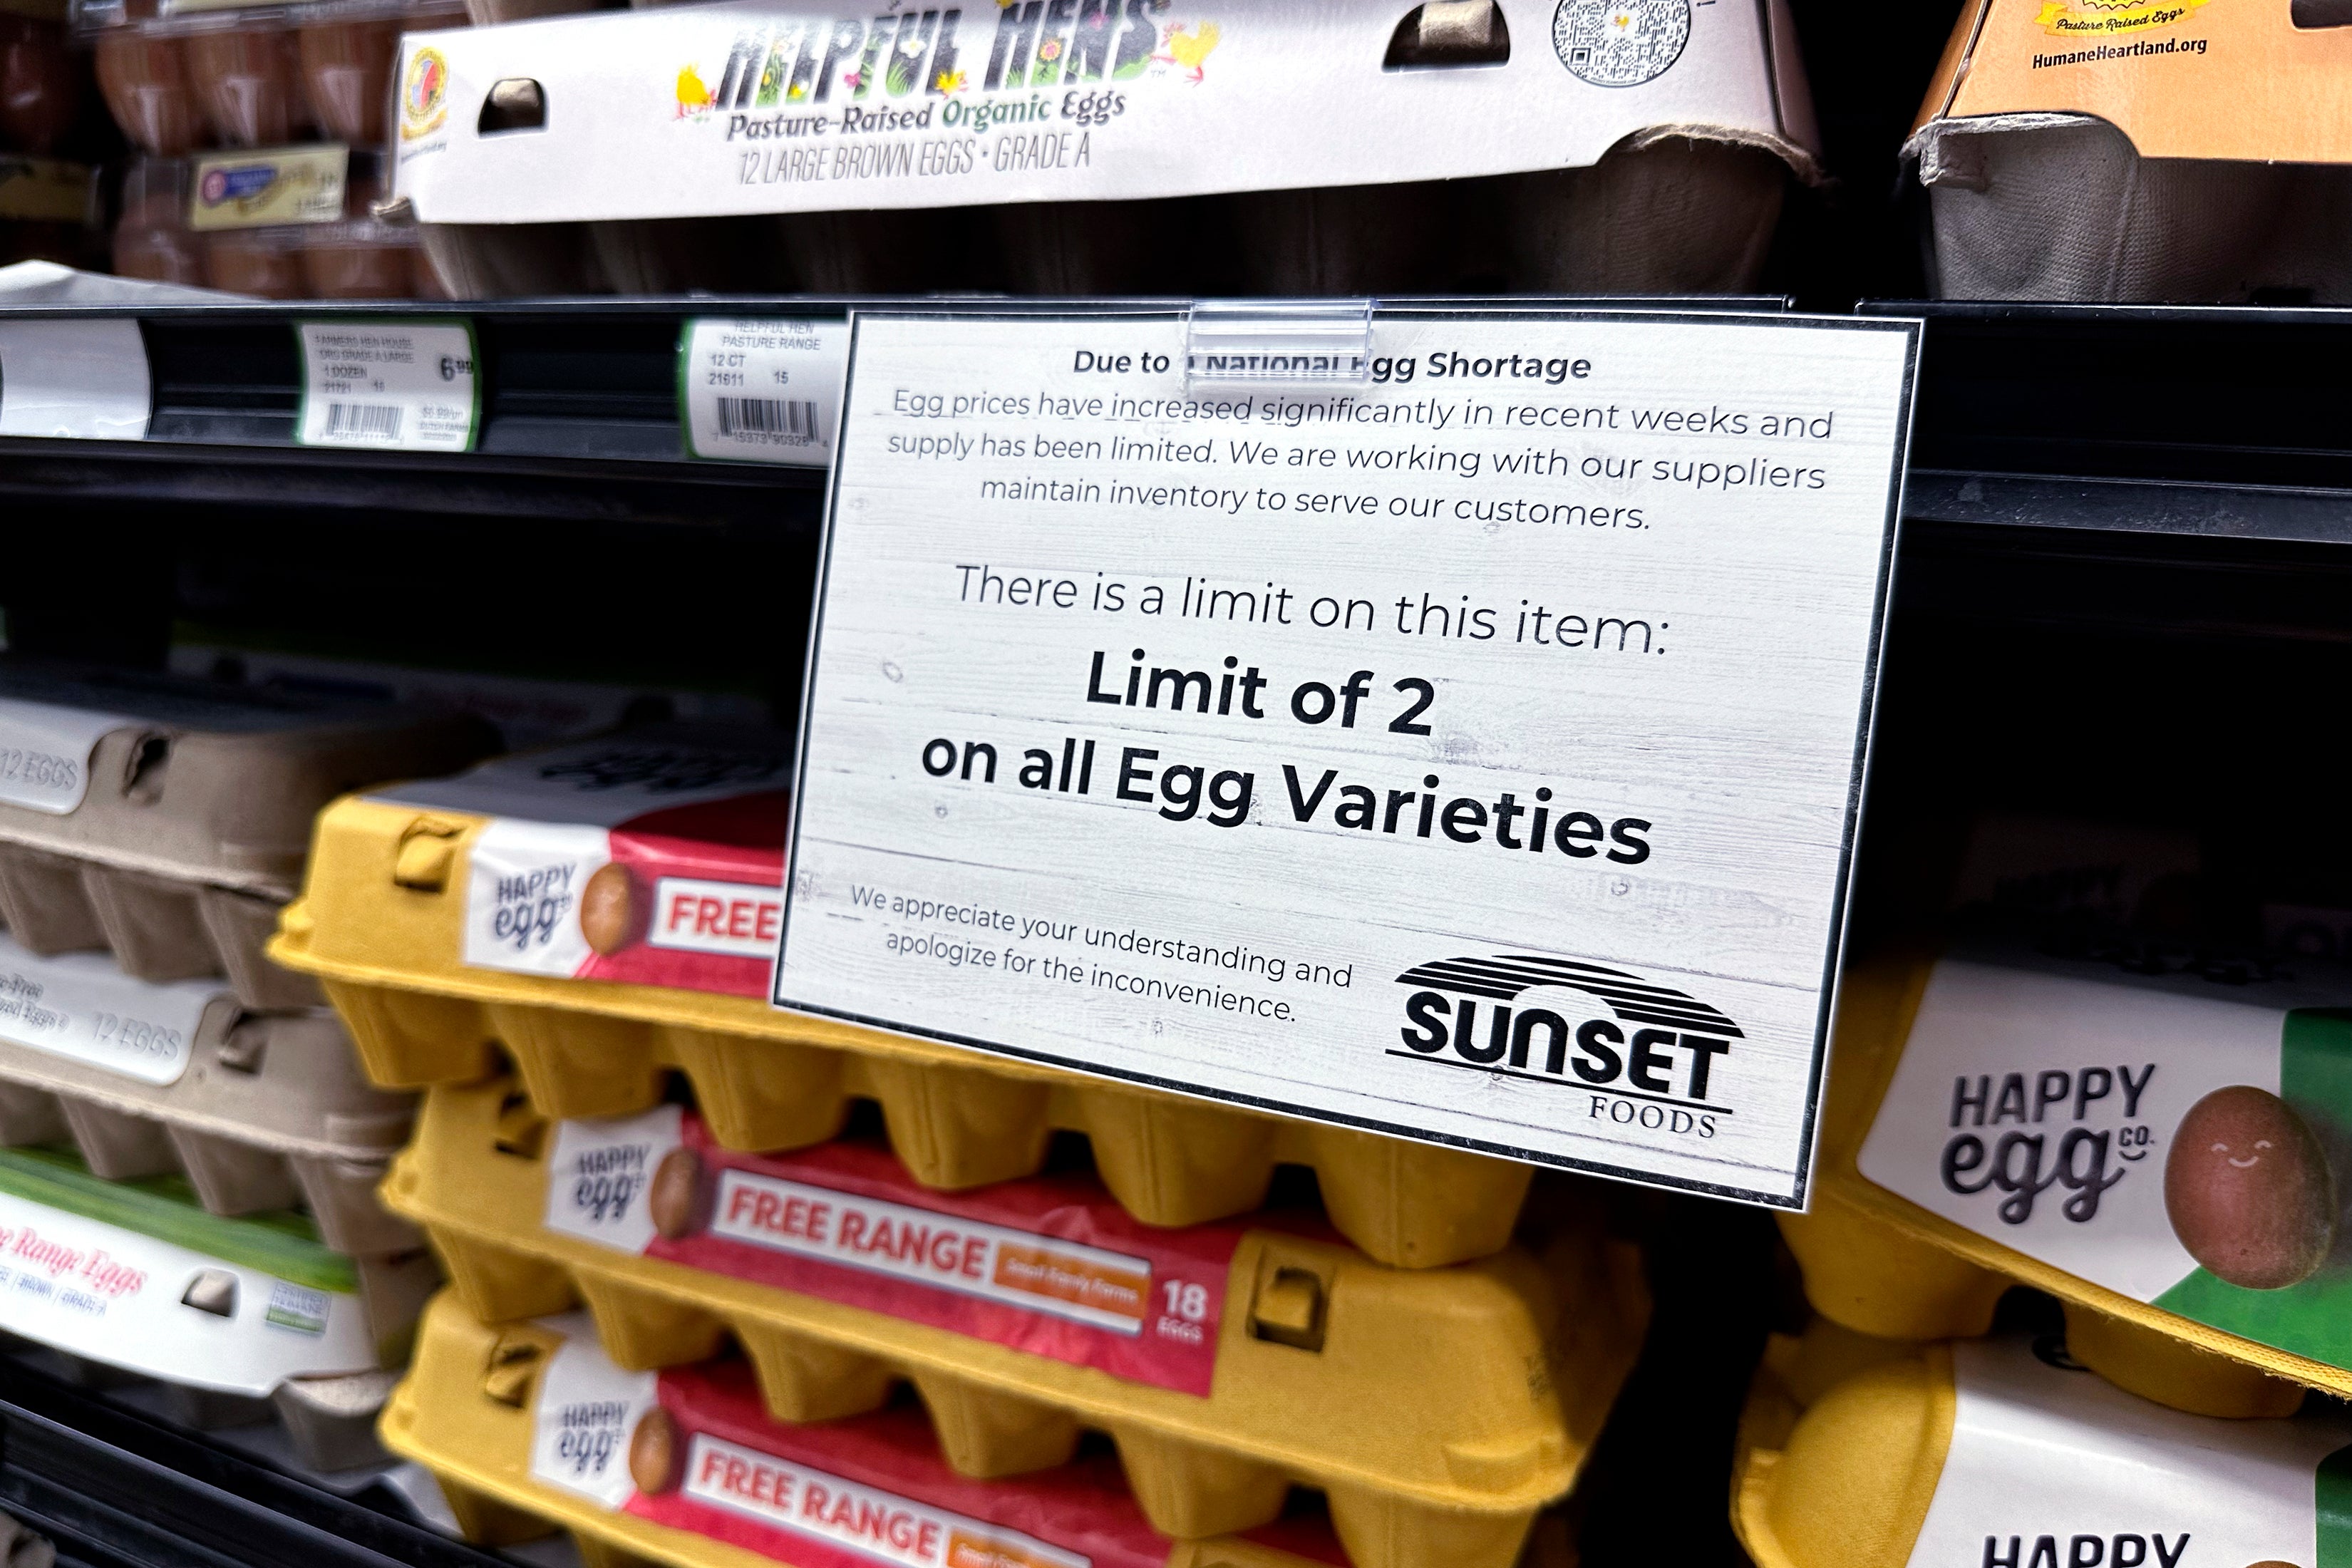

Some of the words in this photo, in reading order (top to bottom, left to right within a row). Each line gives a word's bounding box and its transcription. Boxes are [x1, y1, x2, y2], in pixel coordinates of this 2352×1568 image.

[2056, 19, 2103, 30] Pasture
[2106, 15, 2150, 31] Raised
[2152, 8, 2186, 23] Eggs
[2032, 38, 2208, 69] HumaneHeartland.org
[727, 103, 933, 141] Pasture-Raised
[943, 96, 1051, 133] Organic
[1061, 91, 1126, 128] Eggs
[740, 152, 760, 185] 12
[764, 148, 827, 183] LARGE
[834, 143, 914, 180] BROWN
[920, 140, 975, 175] EGGS
[996, 133, 1070, 172] GRADE
[1076, 131, 1090, 167] A
[711, 354, 726, 367] 12
[727, 354, 746, 367] CT
[722, 336, 775, 349] PASTURE
[779, 338, 822, 351] RANGE
[331, 366, 368, 378] DOZEN
[774, 371, 789, 384] 15
[1074, 351, 1131, 373] Due
[1141, 352, 1170, 373] to
[1427, 351, 1591, 385] Shortage
[894, 390, 944, 418] Egg
[951, 391, 1030, 418] prices
[1039, 392, 1103, 416] have
[1113, 393, 1252, 419] increased
[1261, 395, 1455, 430] significantly
[1465, 399, 1492, 424] in
[1506, 406, 1619, 428] recent
[1631, 406, 1748, 434] weeks
[1761, 411, 1832, 438] and
[888, 432, 974, 460] supply
[981, 433, 1026, 457] has
[1035, 434, 1100, 459] been
[1112, 436, 1216, 463] limited.
[1231, 441, 1277, 465] We
[1288, 448, 1336, 467] are
[1347, 445, 1480, 478] working
[1493, 448, 1567, 475] with
[1582, 458, 1642, 478] our
[1652, 458, 1825, 490] suppliers
[982, 477, 1100, 502] maintain
[1110, 480, 1248, 515] inventory
[1257, 488, 1286, 510] to
[1295, 494, 1378, 515] serve
[1389, 497, 1445, 517] our
[1455, 500, 1649, 529] customers.
[956, 565, 1077, 608] There
[1094, 572, 1125, 612] is
[1140, 587, 1163, 614] a
[1182, 577, 1293, 624] limit
[1310, 598, 1373, 631] on
[1396, 593, 1496, 639] this
[1517, 599, 1668, 654] item:
[1087, 649, 1265, 718] Limit
[1291, 671, 1374, 728] of
[1388, 678, 1434, 736] 2
[24, 751, 78, 791] EGGS
[922, 738, 997, 783] on
[1019, 738, 1095, 795] all
[1116, 747, 1255, 827] Egg
[1282, 765, 1651, 865] Varieties
[497, 862, 577, 904] HAPPY
[495, 898, 562, 949] egg
[668, 894, 781, 942] FREE
[852, 885, 886, 909] We
[893, 897, 1015, 931] appreciate
[1020, 918, 1077, 941] your
[1085, 928, 1285, 980] understanding
[1296, 964, 1352, 988] and
[887, 934, 996, 967] apologize
[1004, 949, 1036, 974] for
[1043, 956, 1083, 982] the
[1091, 963, 1295, 1022] inconvenience.
[92, 1011, 118, 1041] 12
[119, 1018, 182, 1061] EGGS
[1589, 1095, 1716, 1138] FOODS
[1949, 1063, 2156, 1128] HAPPY
[577, 1142, 652, 1175] HAPPY
[1941, 1126, 2126, 1224] egg
[577, 1175, 635, 1222] egg
[726, 1184, 833, 1242] FREE
[837, 1207, 991, 1279] RANGE
[13, 1227, 86, 1279] Range
[81, 1249, 148, 1299] Eggs
[1162, 1279, 1208, 1321] 18
[1156, 1316, 1203, 1345] EGGS
[563, 1401, 630, 1428] HAPPY
[701, 1449, 797, 1510] FREE
[802, 1480, 940, 1561] RANGE
[1982, 1533, 2191, 1568] HAPPY
